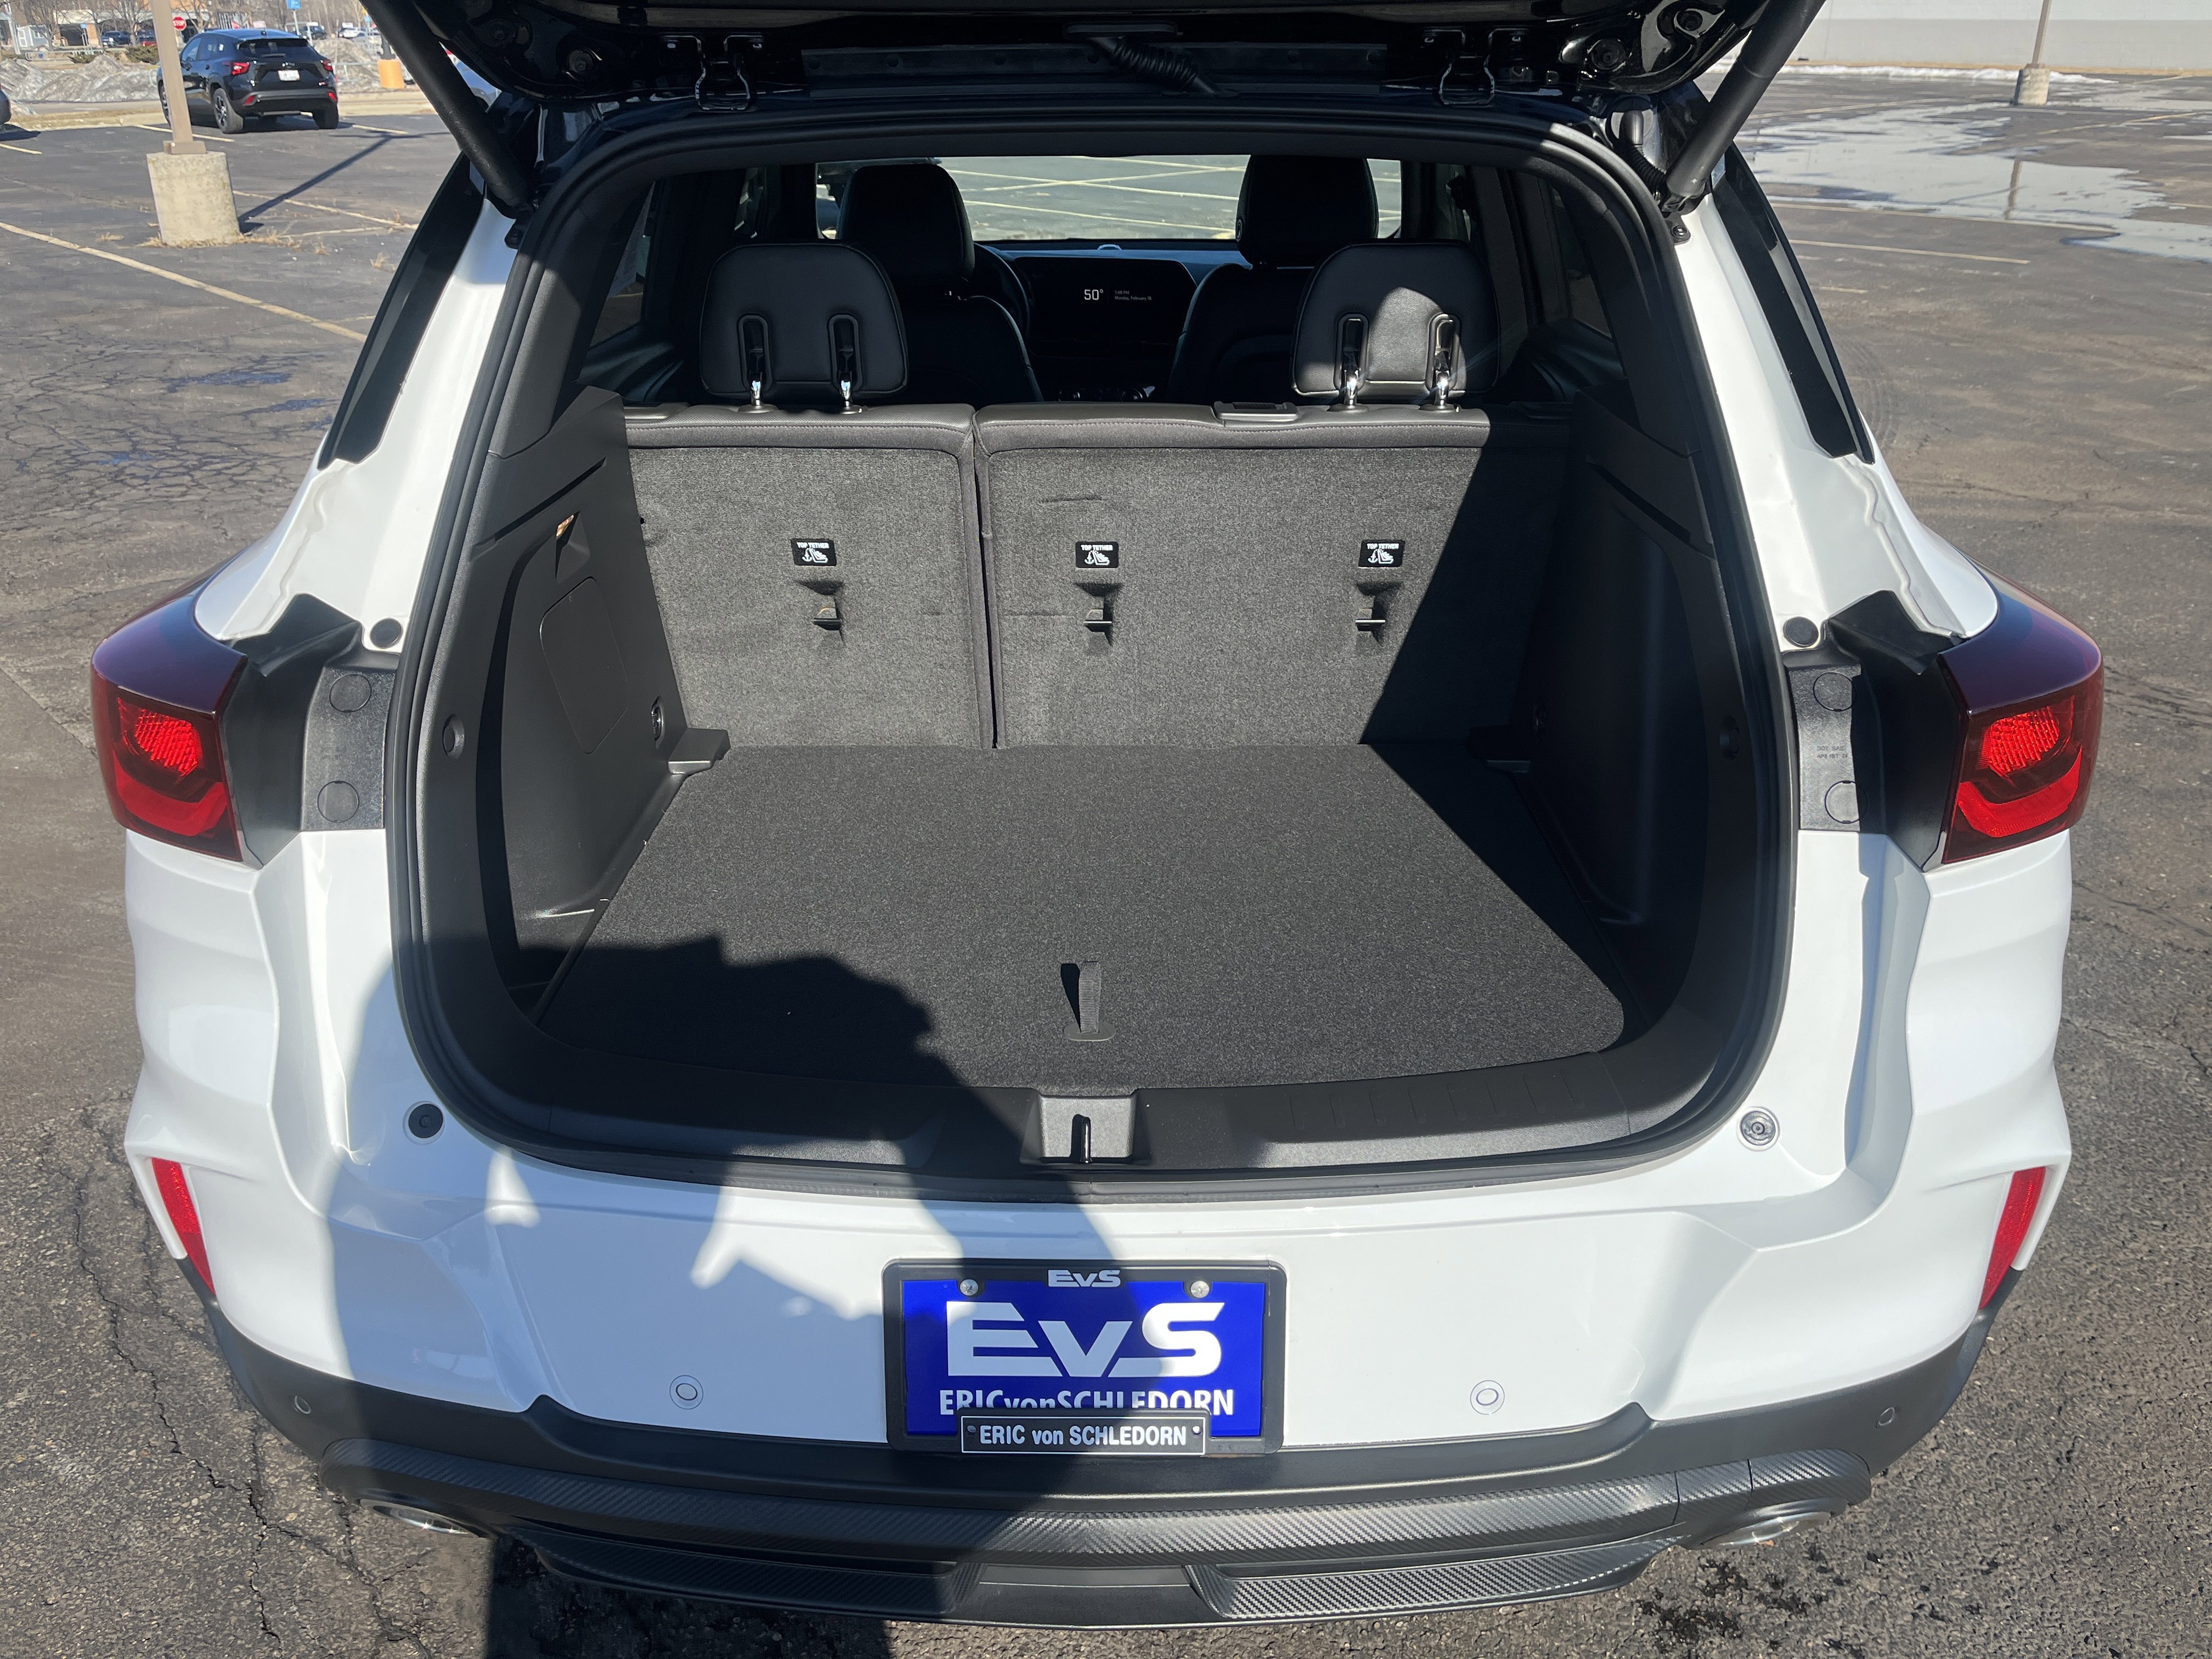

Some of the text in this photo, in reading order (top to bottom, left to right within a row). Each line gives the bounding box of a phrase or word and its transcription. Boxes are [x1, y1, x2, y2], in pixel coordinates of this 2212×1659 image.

[980, 1425, 1186, 1446] ERIC von SCHLEDORN
